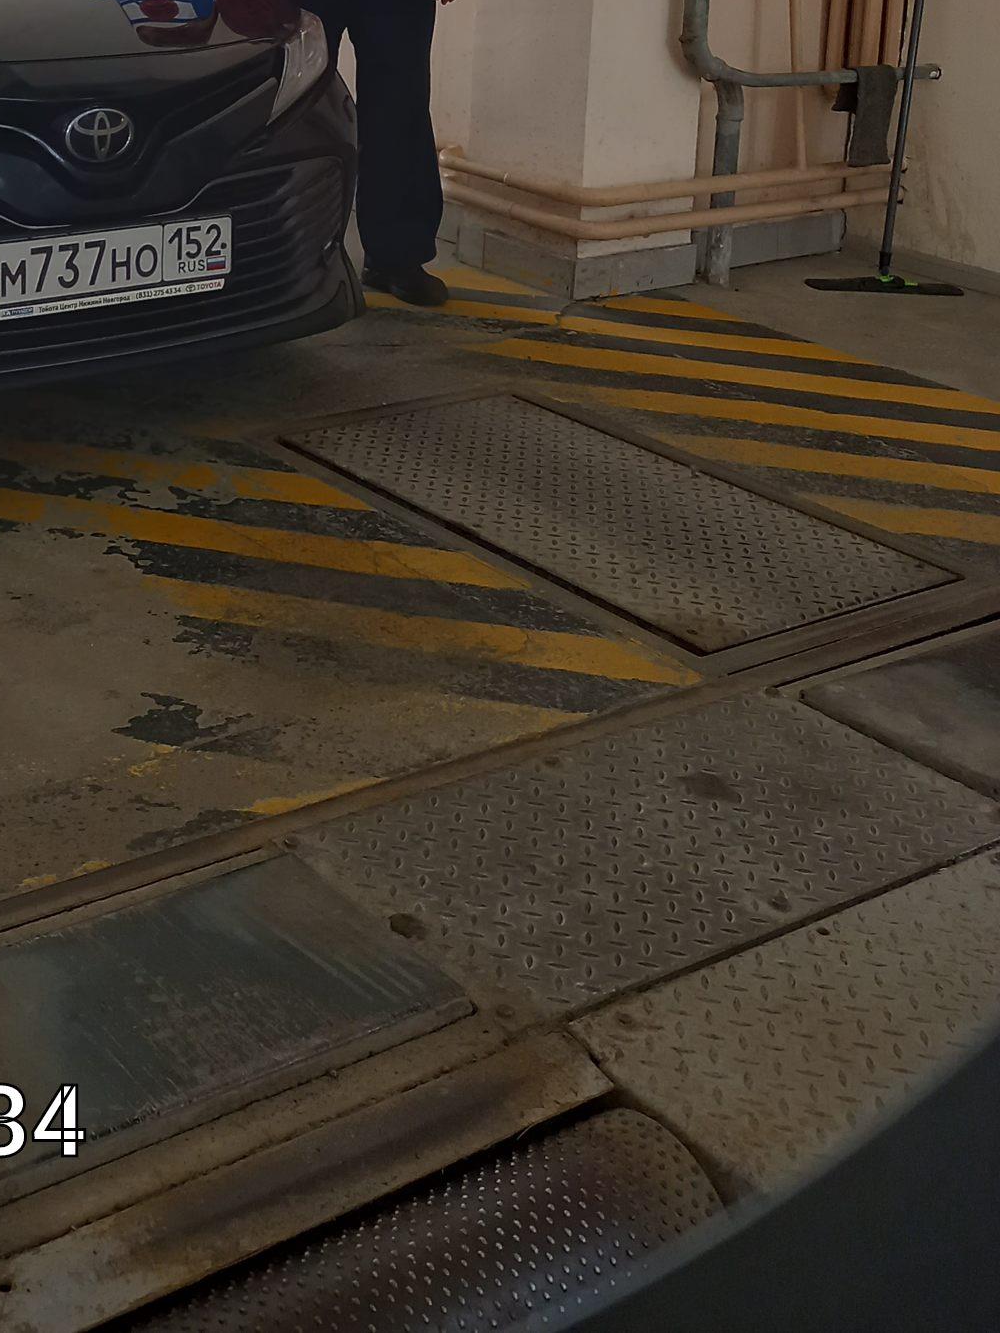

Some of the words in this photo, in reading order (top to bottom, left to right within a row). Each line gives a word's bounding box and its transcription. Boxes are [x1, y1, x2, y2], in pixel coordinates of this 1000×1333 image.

[0, 238, 159, 298] М737НО
[168, 223, 222, 261] 152
[178, 259, 206, 275] RUS
[197, 281, 222, 291] TOYOTA
[39, 304, 59, 314] Тойота
[60, 302, 78, 312] Центр
[79, 298, 102, 308] Нижний
[103, 294, 131, 305] Новгород
